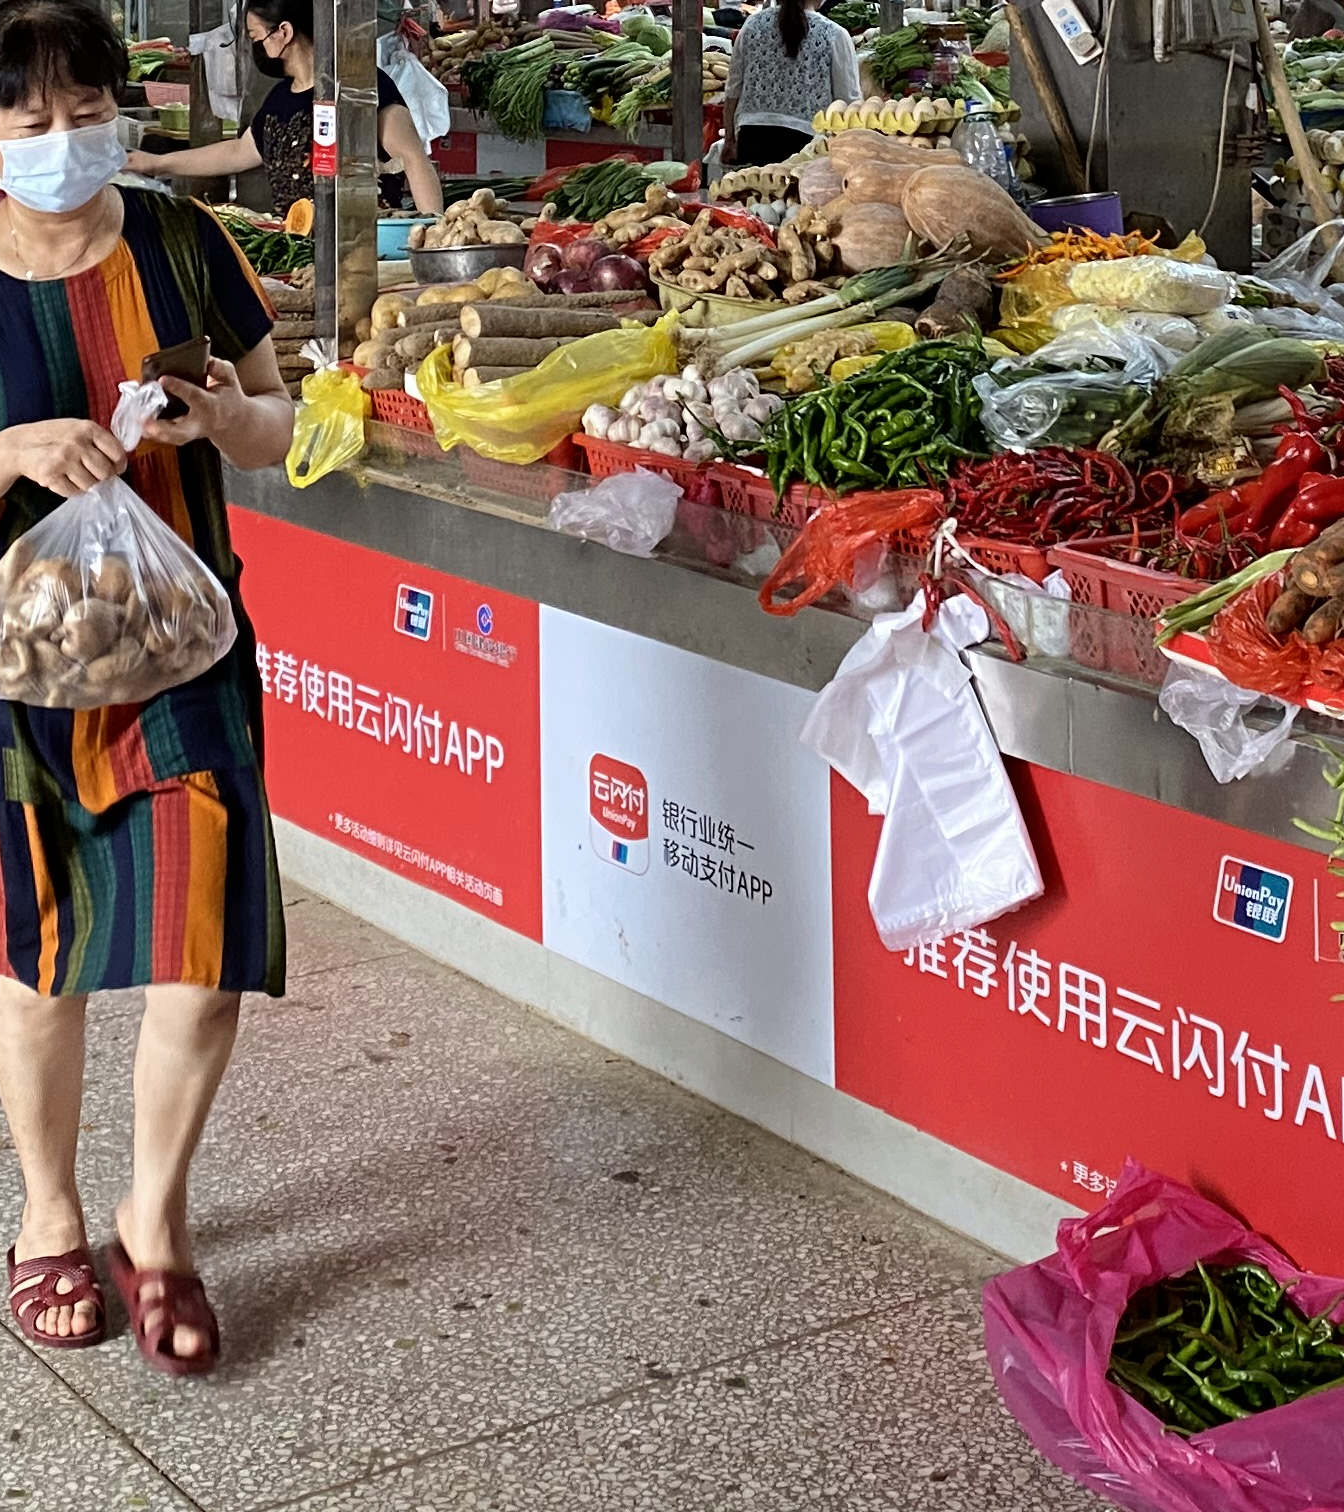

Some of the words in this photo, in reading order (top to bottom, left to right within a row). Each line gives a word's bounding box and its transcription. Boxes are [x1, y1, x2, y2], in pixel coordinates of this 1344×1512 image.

[593, 771, 645, 816] 云闪付
[662, 798, 755, 856] 银行业统一
[662, 838, 773, 904] 移动支付APP
[1223, 874, 1284, 909] UnionPay
[1246, 900, 1279, 926] 银联
